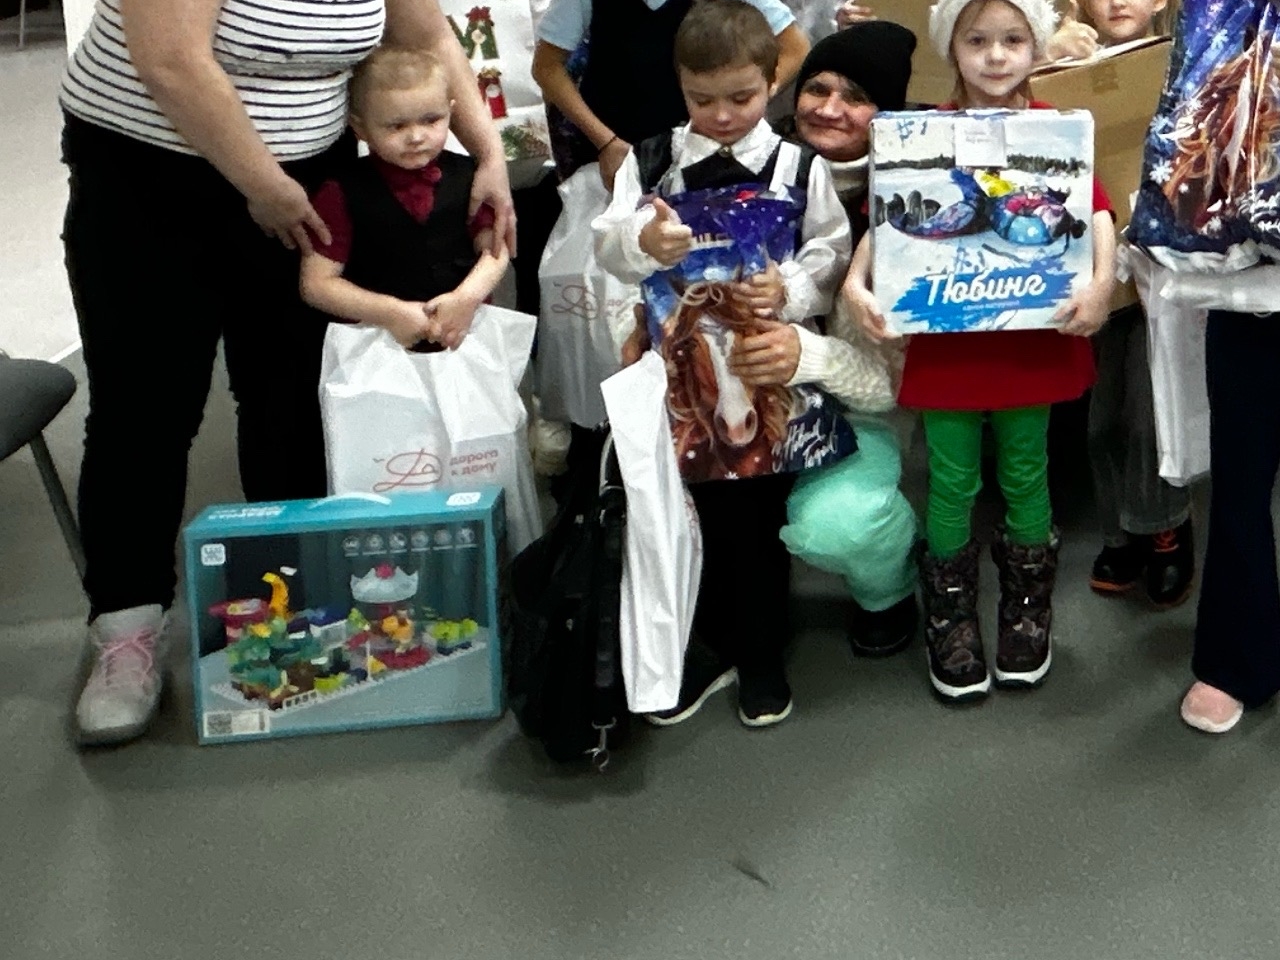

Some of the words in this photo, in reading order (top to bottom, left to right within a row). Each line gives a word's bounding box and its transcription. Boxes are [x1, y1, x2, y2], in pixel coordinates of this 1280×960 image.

[925, 267, 1047, 306] Тюбинг
[449, 449, 498, 466] дорога
[462, 462, 497, 476] дому
